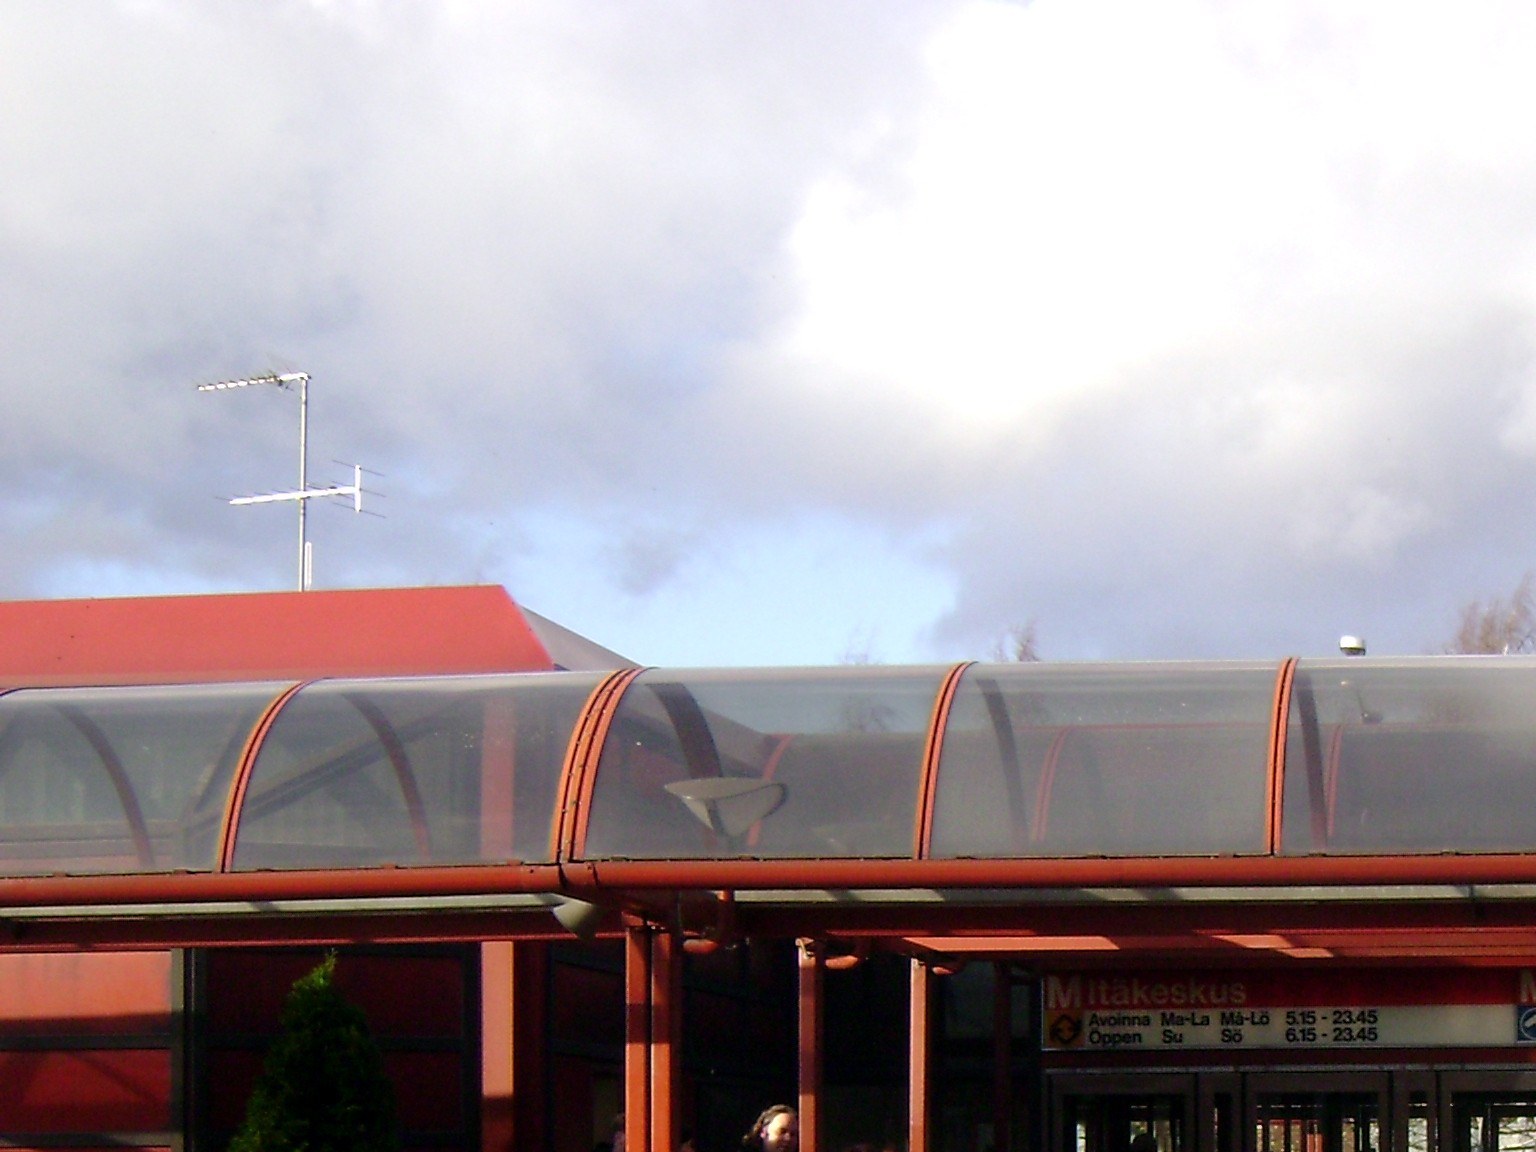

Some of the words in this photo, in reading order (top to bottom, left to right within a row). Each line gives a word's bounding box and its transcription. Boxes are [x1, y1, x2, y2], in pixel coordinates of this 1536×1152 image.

[1047, 975, 1081, 1008] M
[1087, 976, 1248, 1005] Itäkeskus
[1088, 1013, 1150, 1027] Avoinna
[1161, 1012, 1210, 1026] Ma-La
[1285, 1010, 1317, 1025] 5.15
[1332, 1010, 1378, 1025] 23.45
[1162, 1029, 1184, 1044] Su
[1220, 1027, 1243, 1043] Sö
[1285, 1027, 1317, 1042] 6.15
[1332, 1027, 1378, 1042] 23.45
